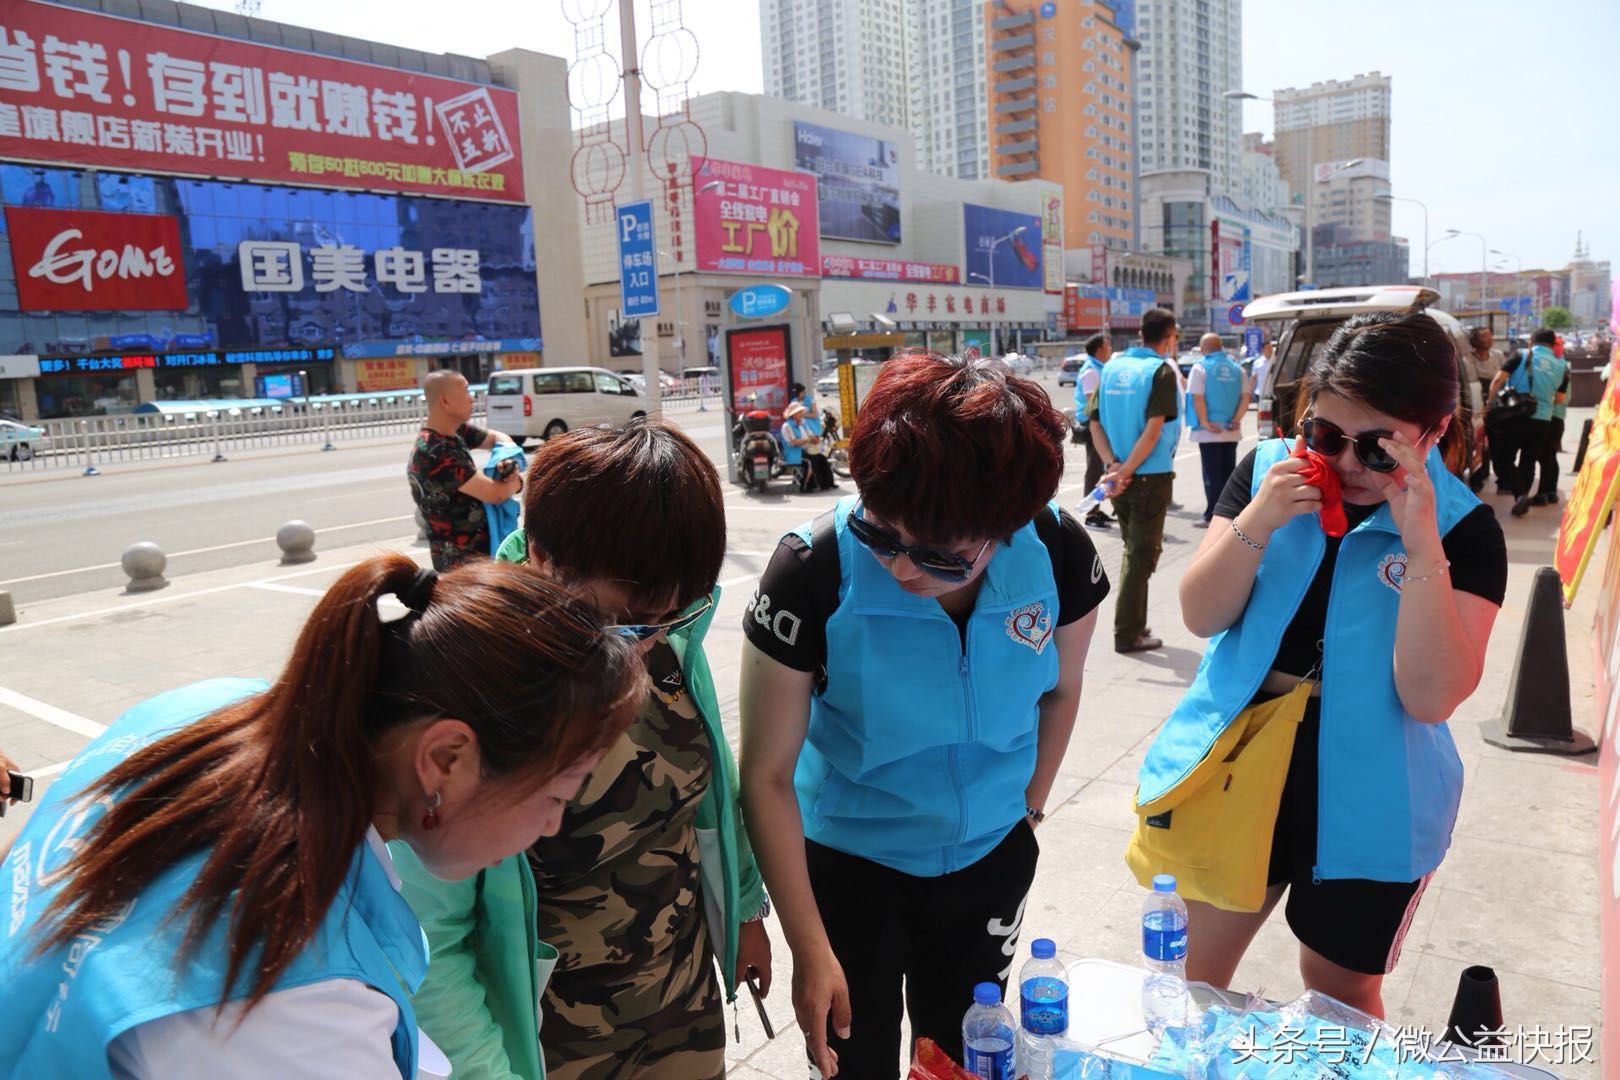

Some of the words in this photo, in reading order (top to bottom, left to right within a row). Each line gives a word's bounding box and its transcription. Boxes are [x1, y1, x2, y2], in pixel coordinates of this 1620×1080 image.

[621, 214, 637, 242] P
[721, 207, 800, 258] 工厂价
[239, 240, 482, 294] 国美电器
[624, 251, 652, 270] 停车场
[630, 271, 649, 288] 入口
[742, 292, 756, 314] P
